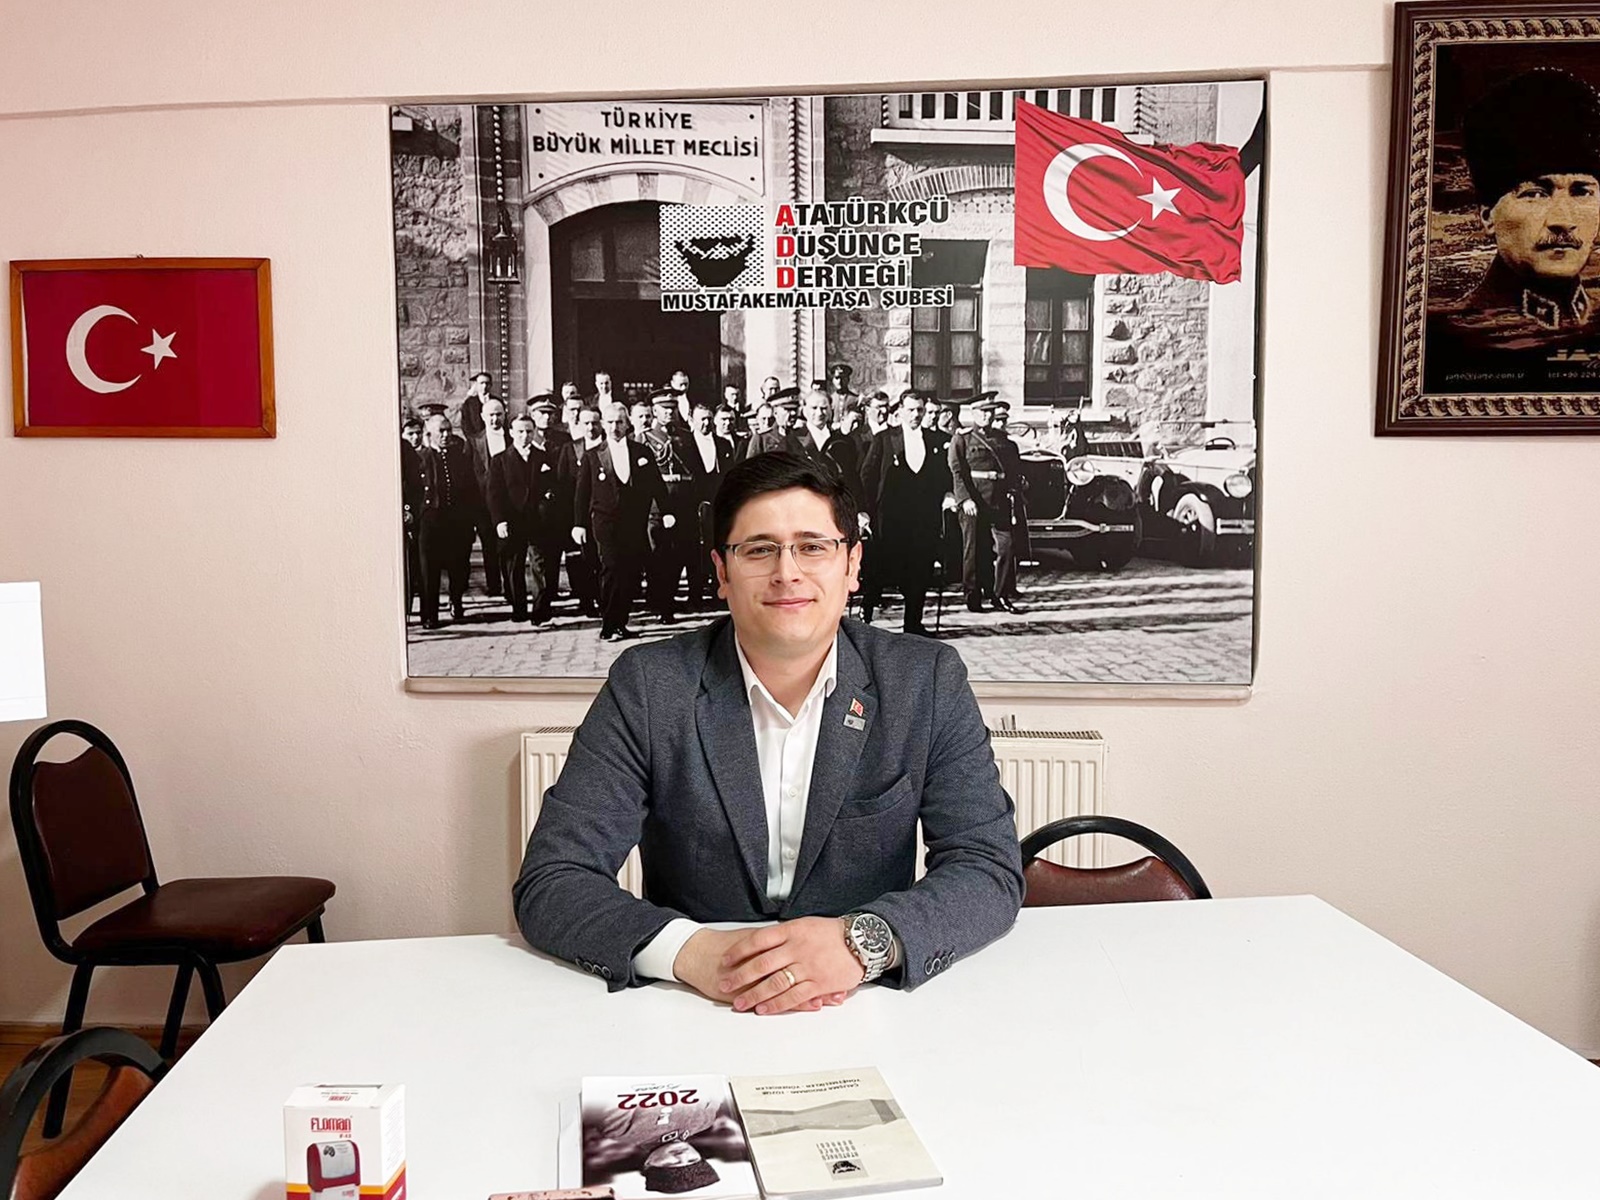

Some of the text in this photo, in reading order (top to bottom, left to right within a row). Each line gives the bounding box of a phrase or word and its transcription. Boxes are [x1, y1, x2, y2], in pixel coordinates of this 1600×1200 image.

[601, 107, 692, 129] TÜRKİYE
[532, 131, 759, 157] BÜYÜK MİLLET MECLİSİ
[775, 196, 949, 227] ATATÜRKÇÜ
[776, 230, 920, 260] DÜŞÜNCE
[776, 259, 906, 288] DERNEĞİ
[663, 286, 952, 310] MUSTAFAKEMALPAŞA ŞUBESİ
[617, 1089, 700, 1110] 2022
